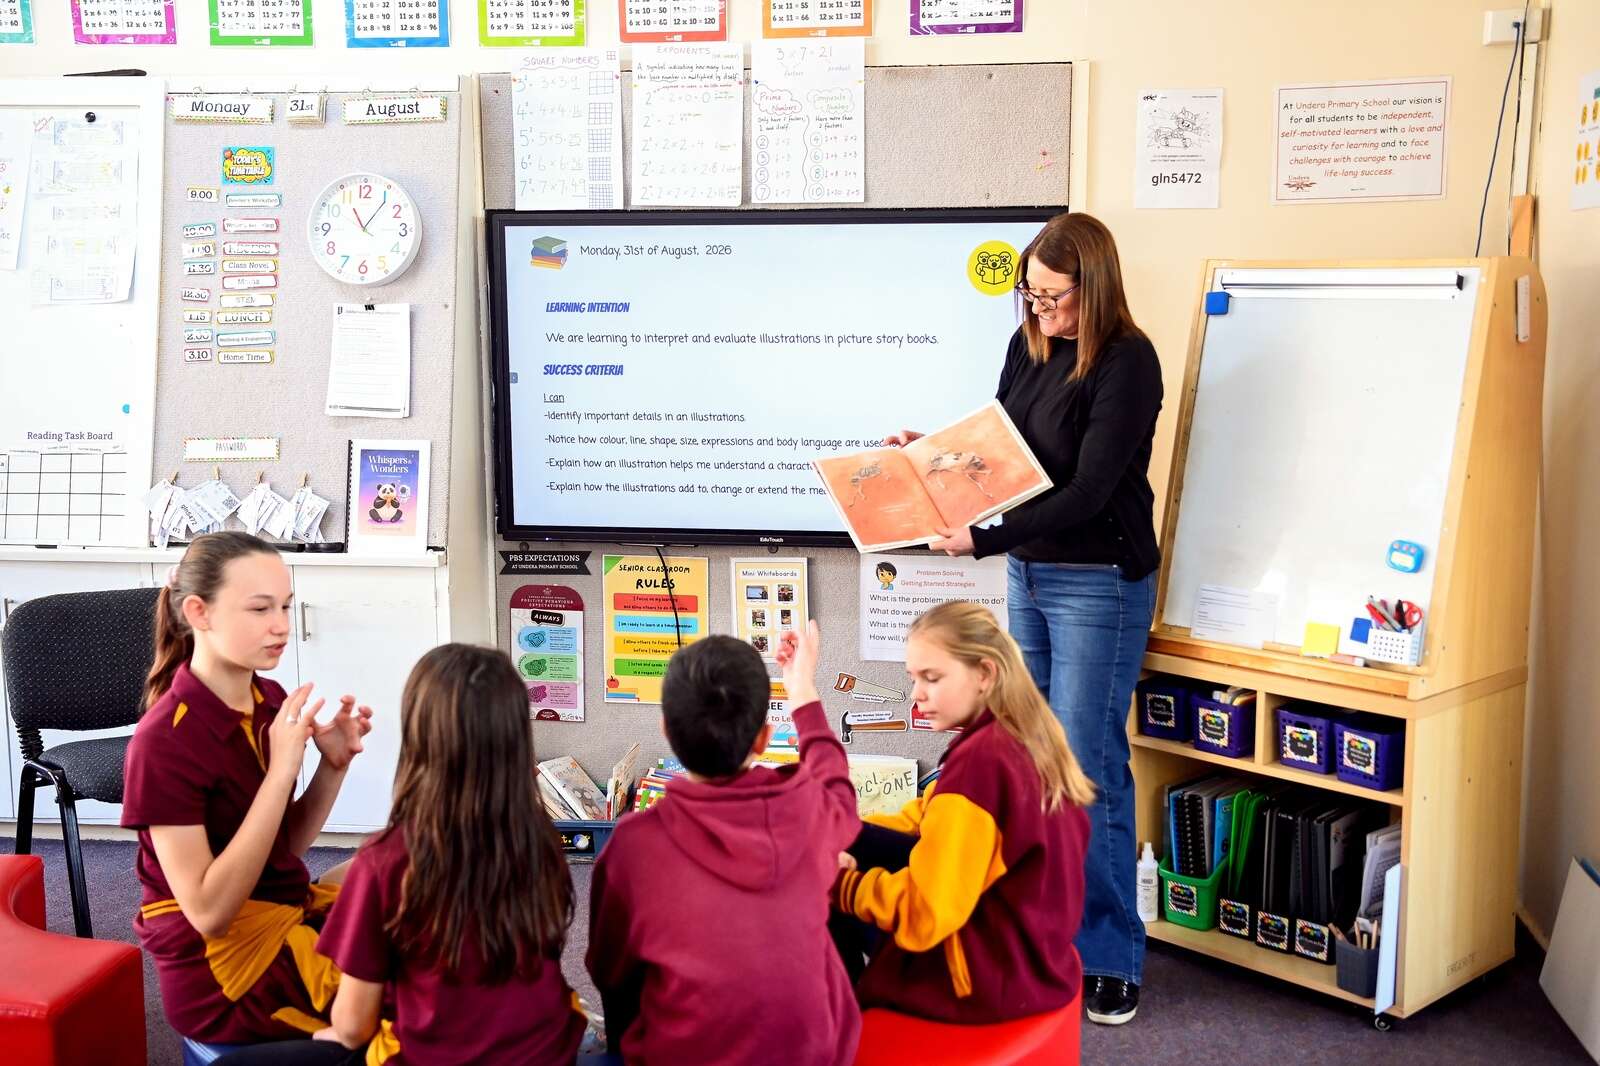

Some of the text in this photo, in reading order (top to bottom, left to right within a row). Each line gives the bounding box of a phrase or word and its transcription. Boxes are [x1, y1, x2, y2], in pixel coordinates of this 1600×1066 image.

[190, 100, 250, 114] Monday
[290, 100, 314, 112] 31st
[366, 101, 421, 117] August
[1296, 102, 1326, 110] Undera
[1328, 100, 1359, 110] Primary
[1362, 99, 1391, 107] School
[1290, 116, 1302, 124] for
[1305, 115, 1315, 123] all
[1317, 114, 1354, 122] students
[1380, 111, 1434, 121] independent,
[1281, 128, 1341, 138] self-motivated
[1344, 127, 1378, 136] learners
[1292, 143, 1328, 152] curiosity
[1331, 142, 1344, 151] for
[1346, 141, 1379, 150] learning
[1381, 140, 1396, 148] and
[1410, 138, 1429, 147] face
[1289, 156, 1331, 166] challenges
[1354, 156, 1386, 164] courage
[1400, 153, 1432, 161] achieve
[1151, 172, 1202, 186] gln5472
[1324, 168, 1358, 178] life-long
[359, 184, 372, 199] 12
[392, 204, 402, 218] 2
[321, 222, 331, 237] 9
[399, 223, 408, 237] 3
[326, 241, 336, 255] 8
[580, 245, 732, 260] Monday, 31st of August, 2026
[358, 259, 368, 274] 6
[546, 302, 630, 313] LEARNING INTENTION
[546, 332, 938, 348] We are learning to interpret and evaluate illustrations in picture story books.
[188, 350, 209, 360] 3.10
[543, 364, 624, 376] SUCCESS CRITERIA
[549, 394, 564, 402] can
[584, 412, 630, 424] important
[632, 412, 662, 422] details
[664, 412, 674, 422] in
[676, 414, 688, 422] an
[27, 431, 113, 442] Reading Task Board
[578, 435, 596, 444] how
[600, 435, 628, 445] colour,
[701, 438, 754, 448] expressions
[756, 438, 774, 446] and
[776, 438, 798, 450] body
[800, 438, 842, 450] language
[845, 440, 860, 448] are
[215, 442, 247, 451] PASSWORDS
[368, 456, 408, 466] Whispers
[583, 458, 602, 468] how
[619, 459, 668, 469] illustration
[670, 460, 694, 472] helps
[696, 462, 711, 470] me
[714, 461, 766, 470] understand
[768, 462, 775, 470] a
[584, 482, 602, 492] how
[605, 482, 620, 492] the
[622, 482, 676, 493] illustrations
[678, 484, 694, 494] add
[710, 484, 742, 498] change
[758, 486, 788, 495] extend
[790, 486, 806, 495] the
[646, 565, 690, 573] CLASROOM
[636, 578, 675, 589] RULES
[869, 594, 889, 602] What
[912, 596, 943, 604] problem
[534, 613, 560, 622] ALWAYS
[857, 770, 915, 798] YCLONE
